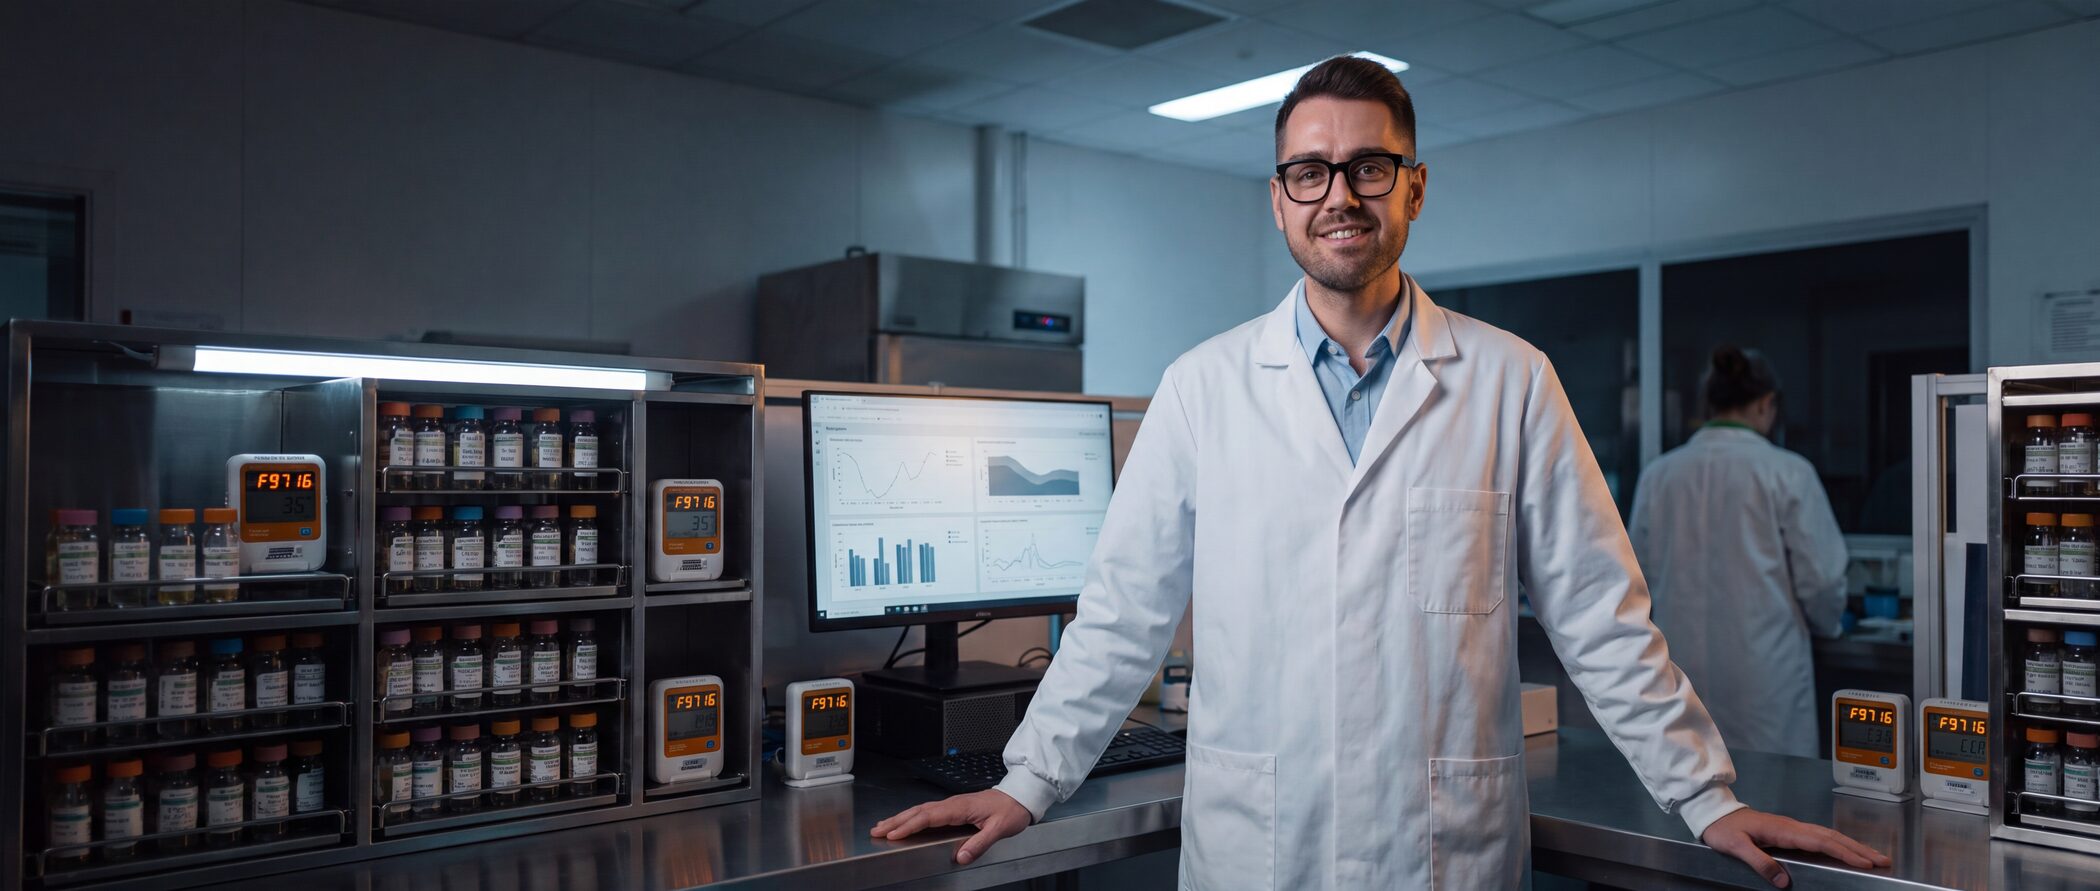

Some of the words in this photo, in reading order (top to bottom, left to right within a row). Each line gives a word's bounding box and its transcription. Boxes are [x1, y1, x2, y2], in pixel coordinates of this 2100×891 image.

[257, 473, 311, 489] F9716
[674, 495, 715, 509] F9716
[676, 693, 716, 708] F9716
[811, 695, 846, 710] F9716
[1850, 707, 1893, 724] F9716
[1939, 717, 1986, 735] F9716
